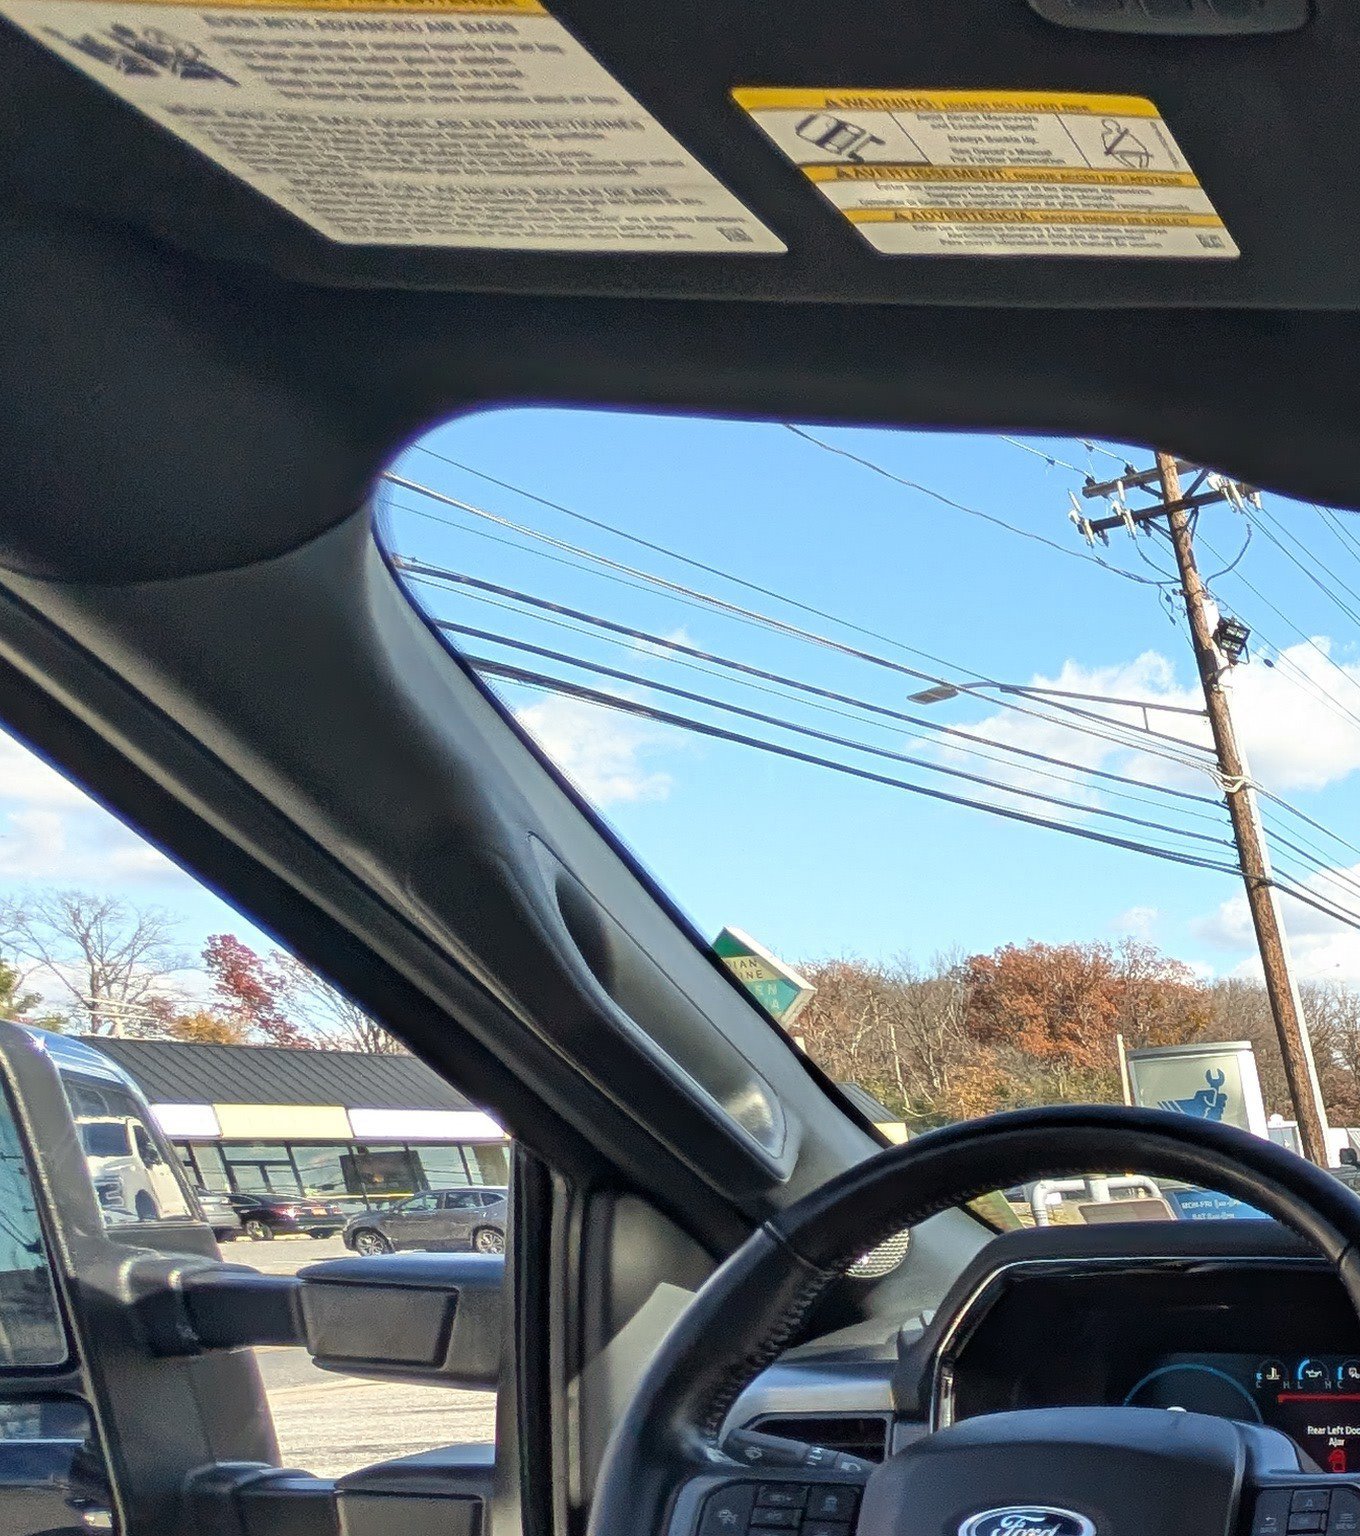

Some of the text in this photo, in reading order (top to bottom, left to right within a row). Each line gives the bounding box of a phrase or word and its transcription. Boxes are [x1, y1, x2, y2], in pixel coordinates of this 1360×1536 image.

[1308, 1426, 1326, 1435] Rear
[1327, 1426, 1344, 1435] Left
[1329, 1438, 1345, 1447] Ajar
